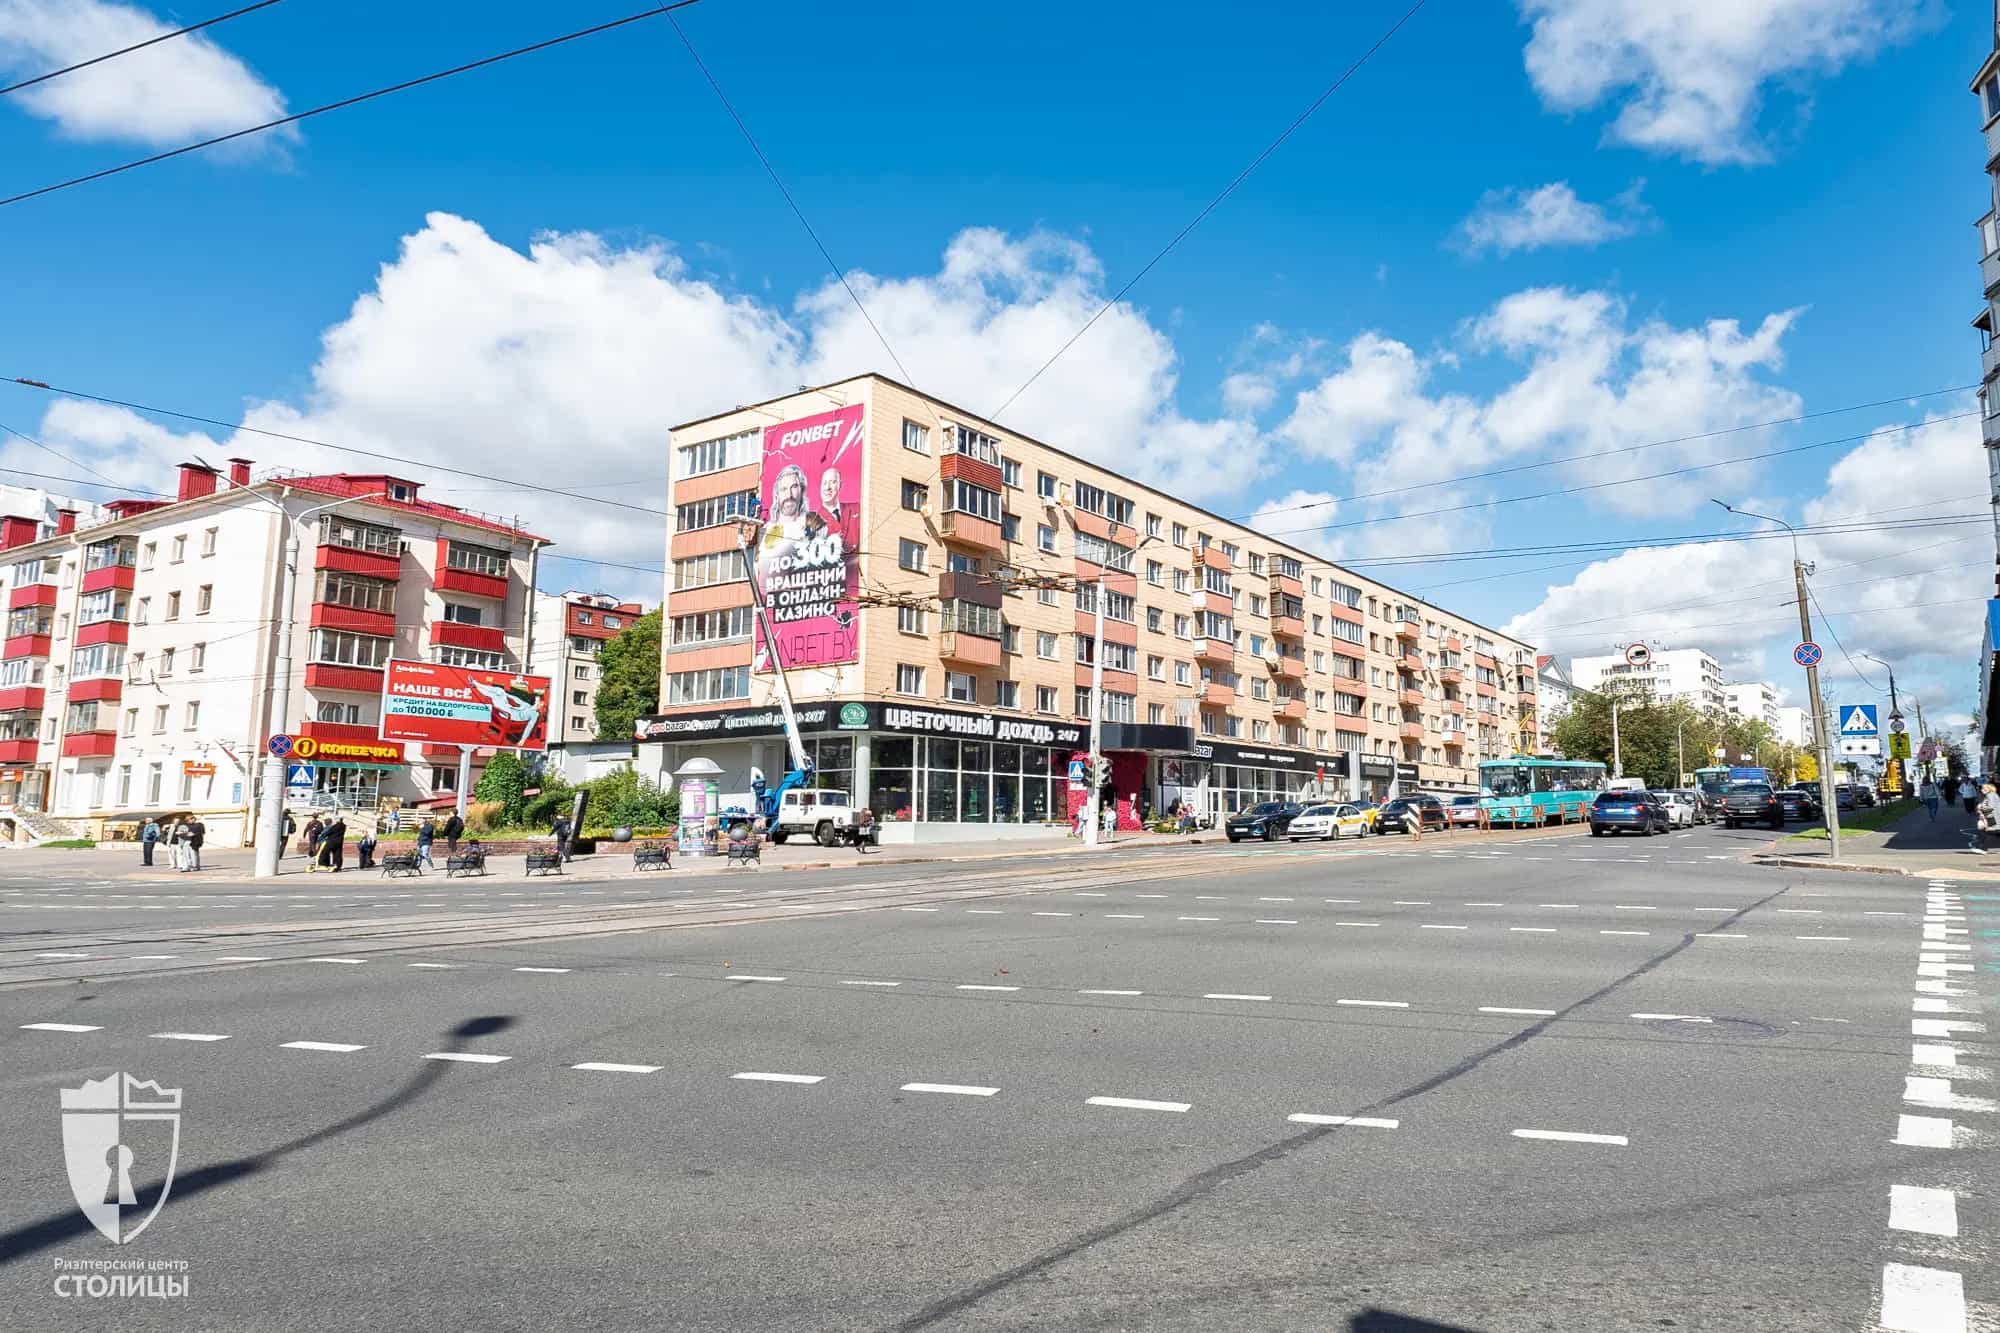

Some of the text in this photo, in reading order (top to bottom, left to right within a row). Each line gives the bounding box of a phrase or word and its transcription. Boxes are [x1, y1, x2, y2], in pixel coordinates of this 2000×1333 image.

[781, 419, 844, 449] FONBET
[768, 533, 842, 574] ДО 300
[766, 562, 846, 591] ВРАЩЕНИЙ
[766, 594, 775, 608] В
[775, 602, 835, 622] КАЗИНО
[393, 682, 473, 699] НАШЕ ВСЁ
[393, 698, 424, 706] КРЕДИТ
[885, 708, 1080, 743] ЦВЕТОЧНЫЙ ДОЖДЬ 24/7
[319, 743, 398, 758] КОПЕЕЧКА
